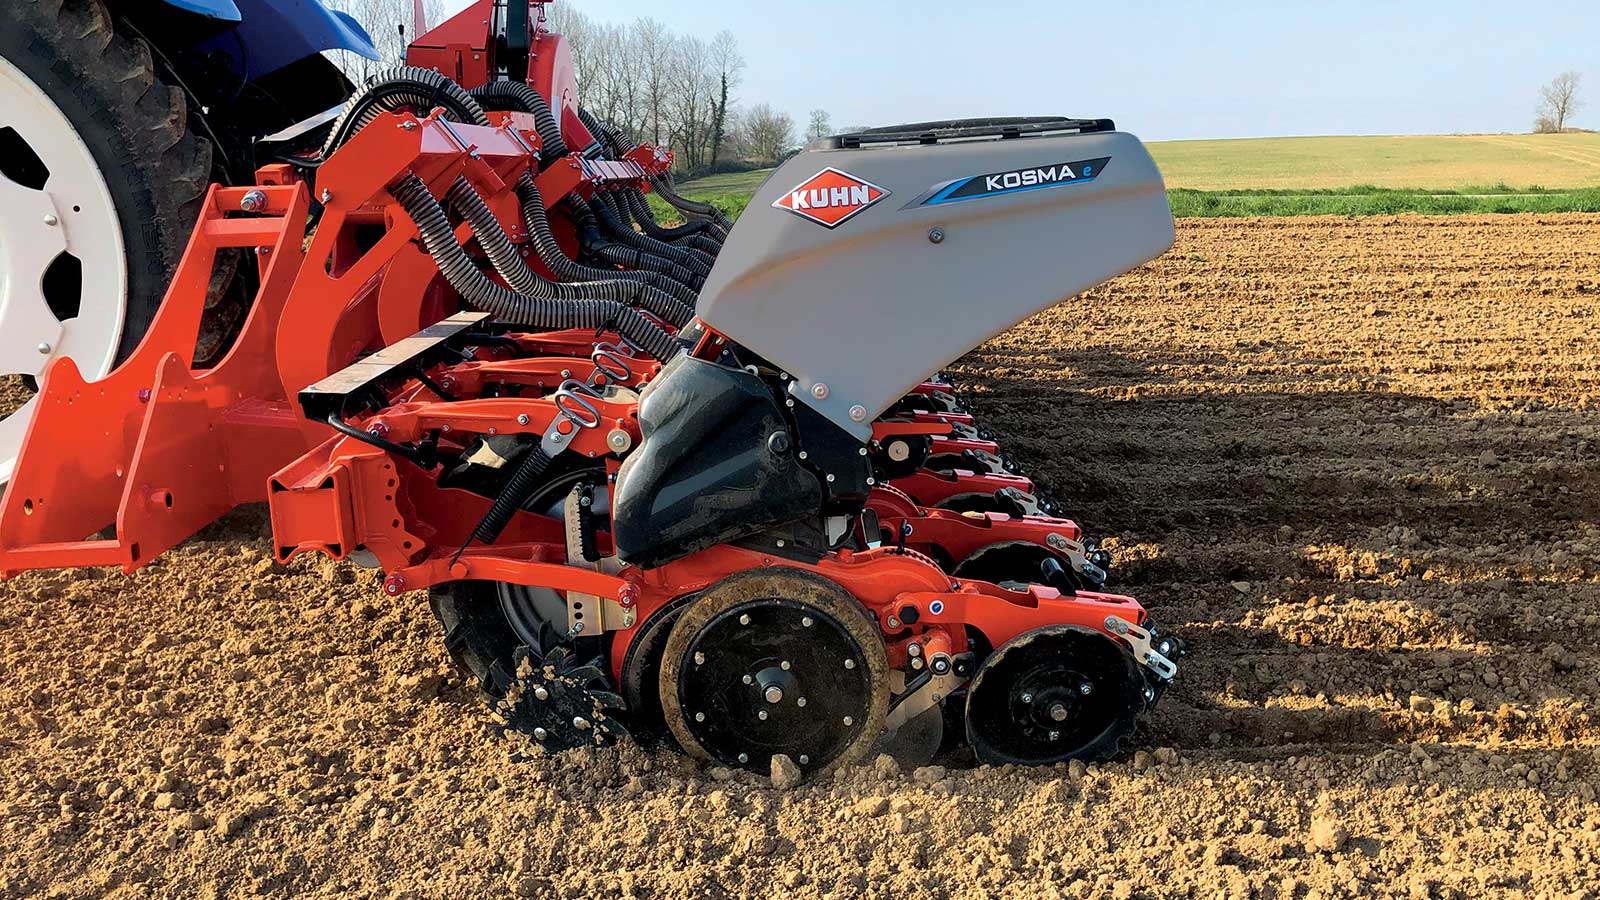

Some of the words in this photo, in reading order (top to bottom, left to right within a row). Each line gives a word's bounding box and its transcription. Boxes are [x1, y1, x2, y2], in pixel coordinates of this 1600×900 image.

[985, 165, 1076, 191] KOSMA
[1083, 165, 1092, 177] e
[791, 184, 870, 210] KUHN
